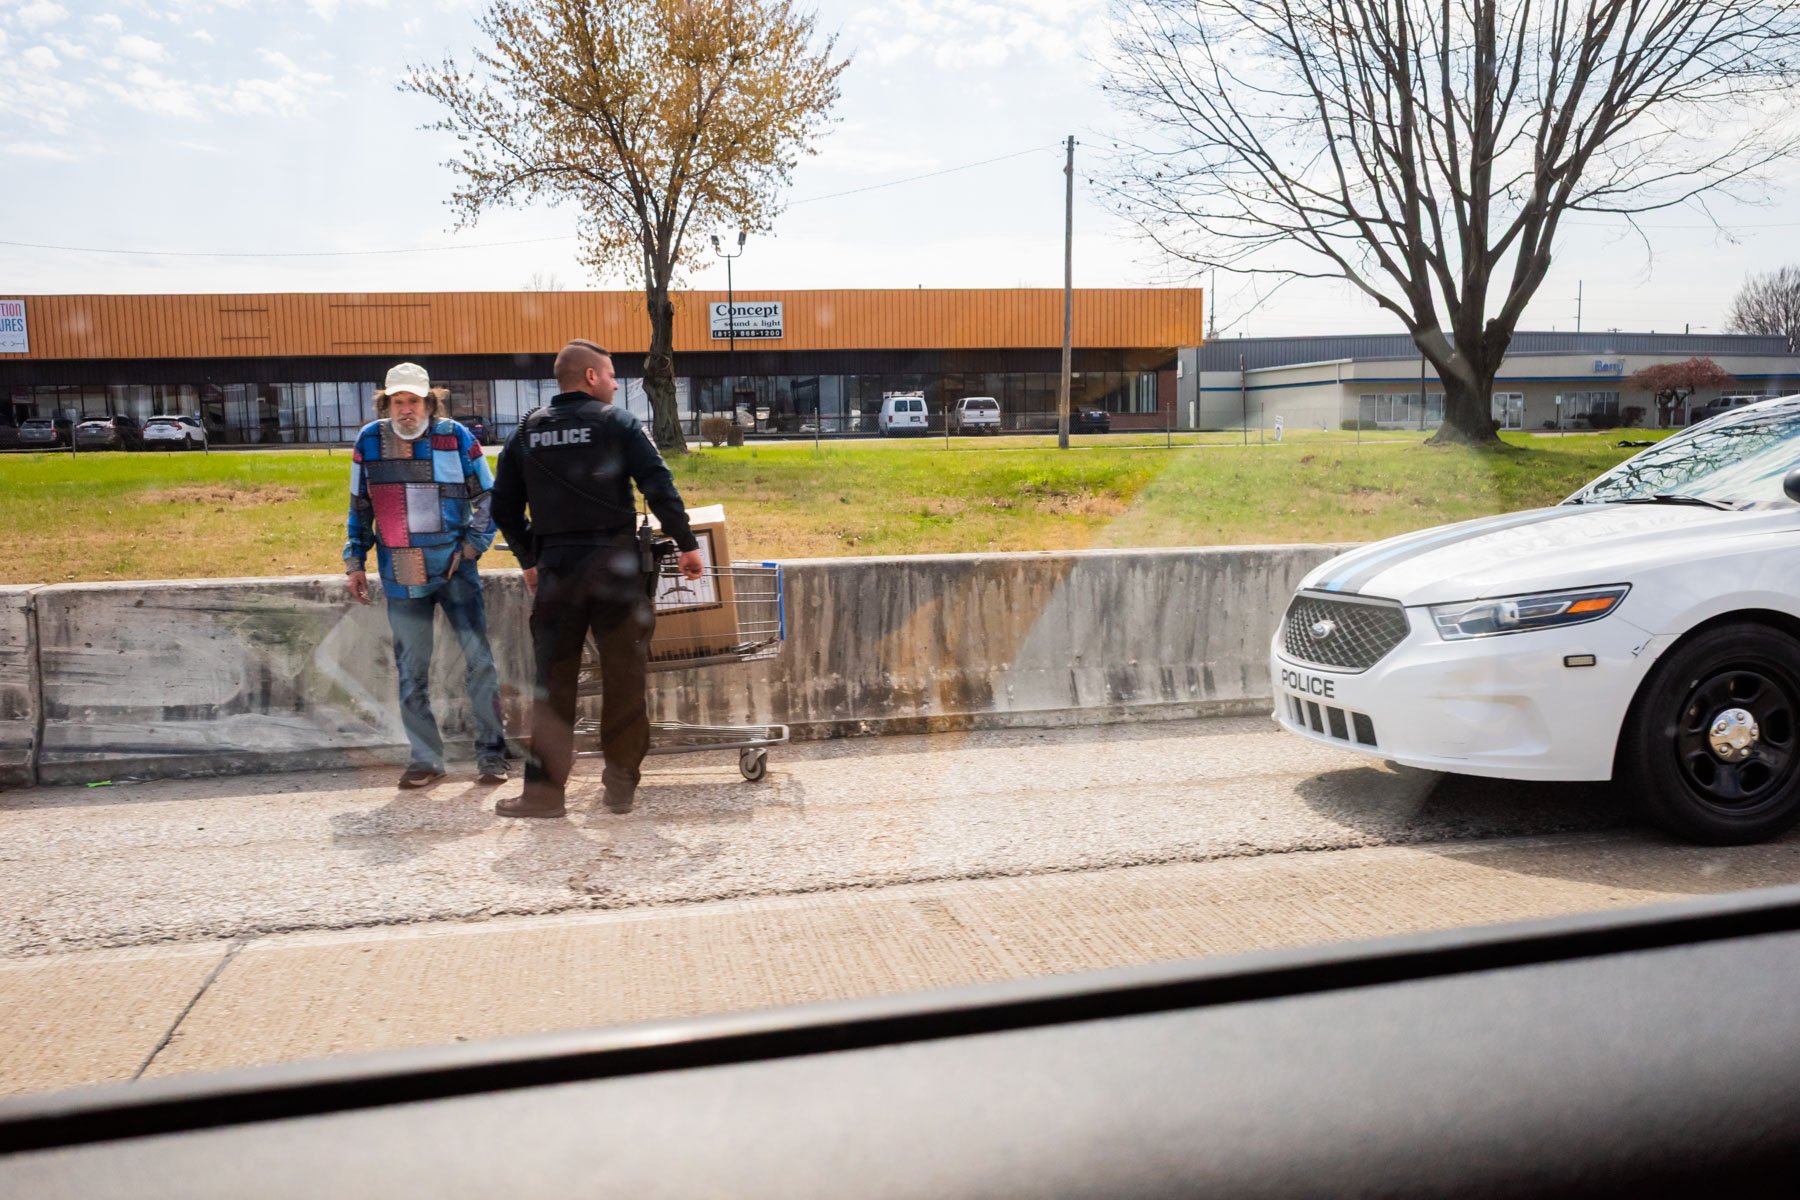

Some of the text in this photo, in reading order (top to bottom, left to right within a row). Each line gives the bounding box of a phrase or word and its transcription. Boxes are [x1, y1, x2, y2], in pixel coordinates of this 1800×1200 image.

[715, 304, 779, 318] Concept
[761, 319, 781, 328] light
[530, 428, 591, 448] POLICE
[1282, 668, 1335, 699] POLICE
